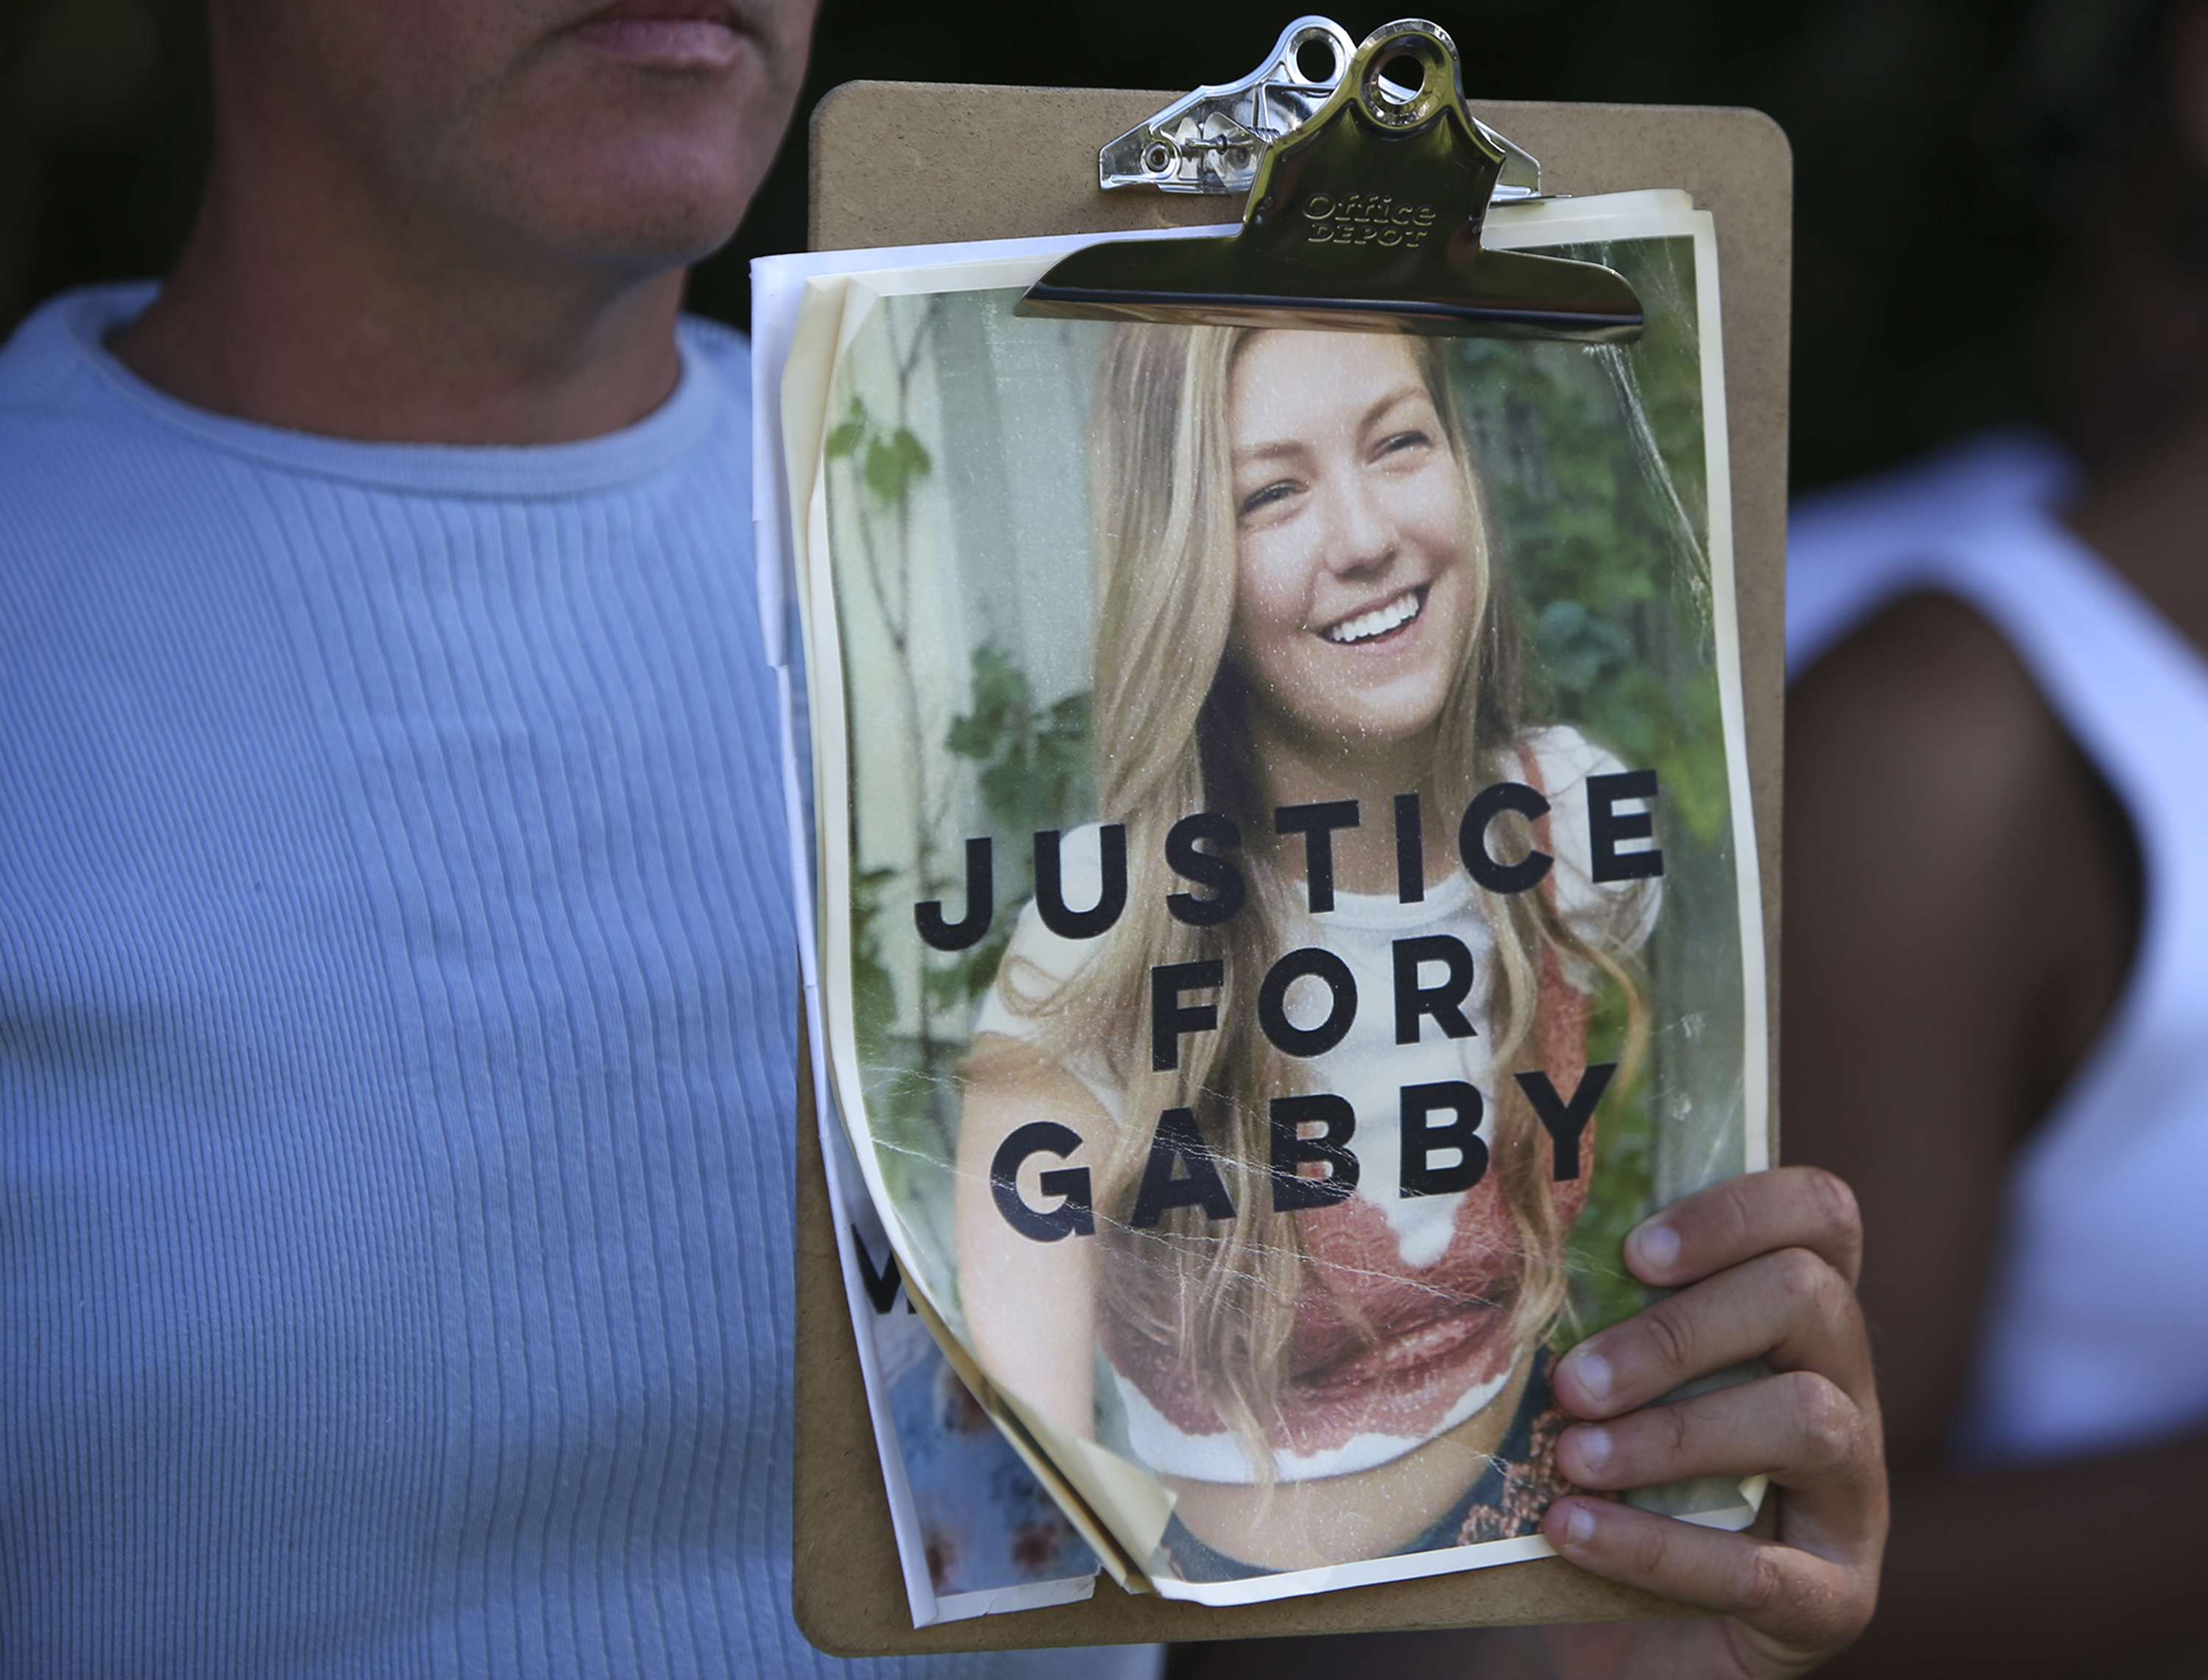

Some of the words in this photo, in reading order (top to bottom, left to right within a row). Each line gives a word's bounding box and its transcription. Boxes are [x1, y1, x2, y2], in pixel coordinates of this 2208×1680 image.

[1302, 192, 1436, 226] Office
[1307, 222, 1428, 247] DEPOT
[914, 769, 1664, 951] JUSTICE
[1151, 935, 1478, 1071] FOR
[990, 1063, 1618, 1244] GABBY
